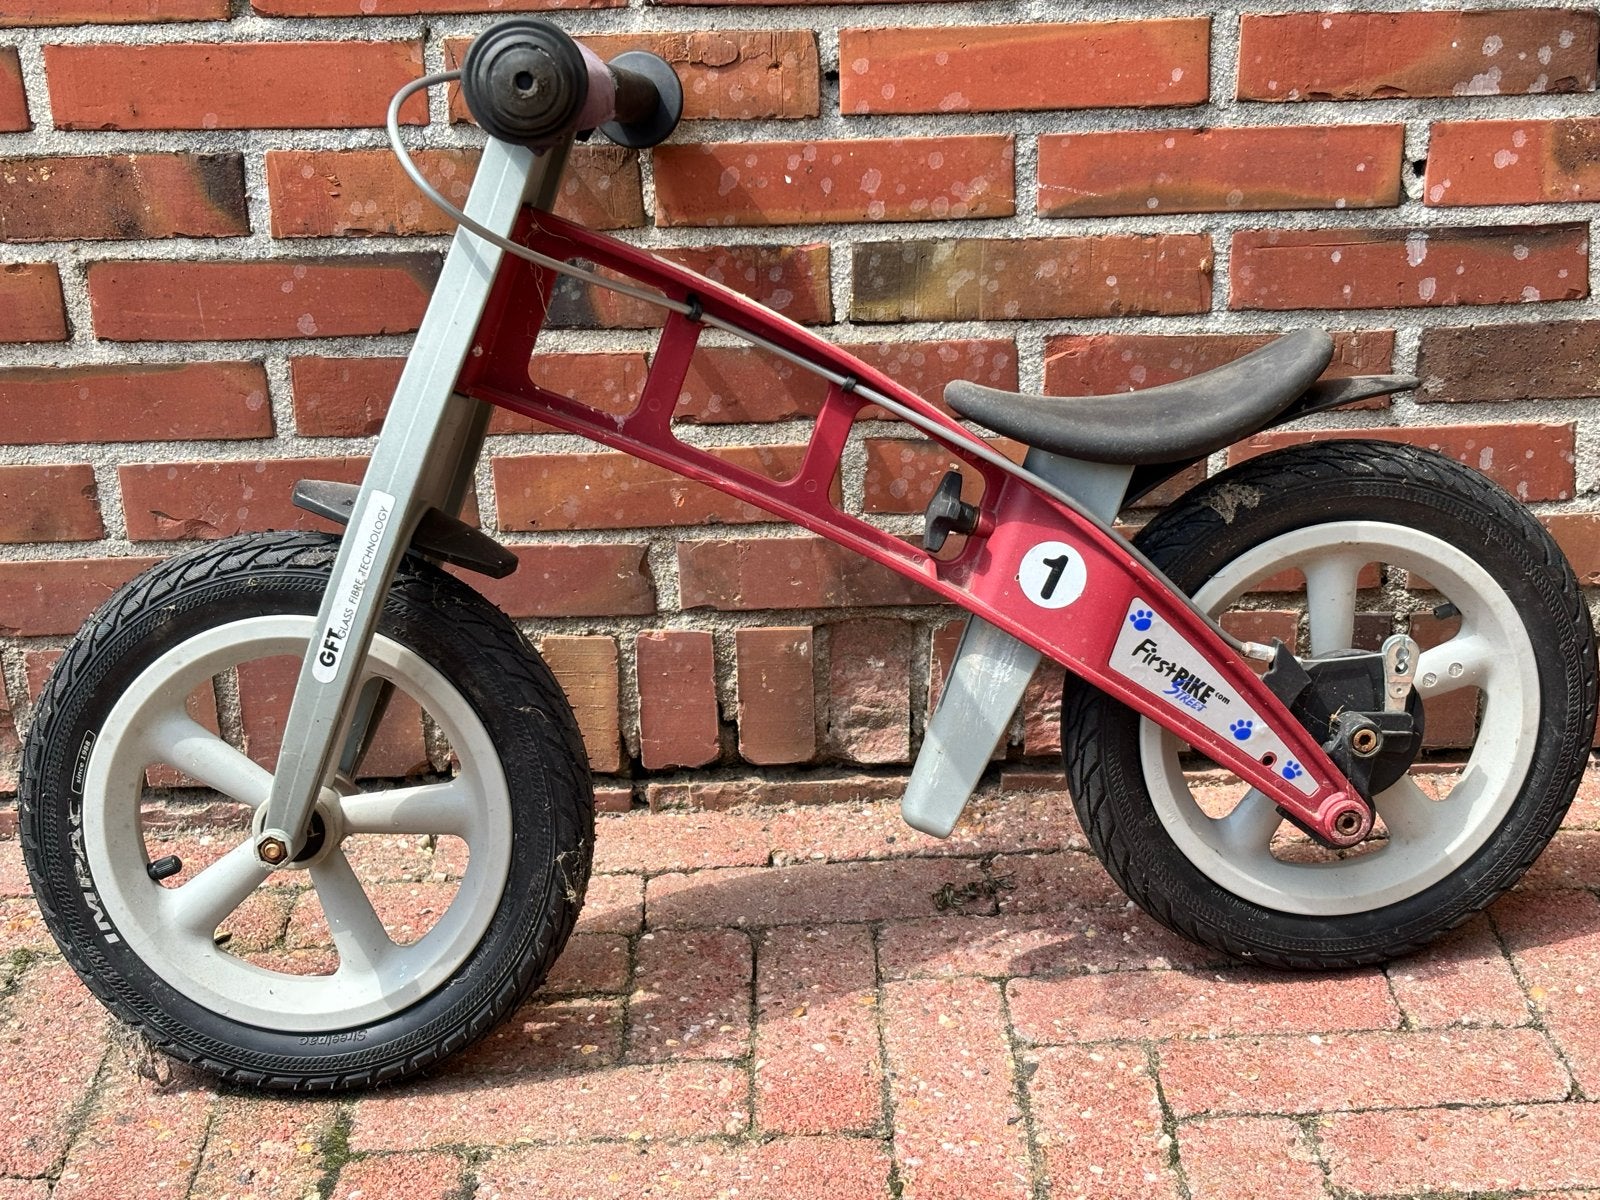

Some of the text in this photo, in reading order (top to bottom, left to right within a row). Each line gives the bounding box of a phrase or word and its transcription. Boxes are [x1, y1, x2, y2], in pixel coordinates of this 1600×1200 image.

[338, 506, 390, 640] GLASS FIBRE TECHNOLOGY
[1040, 555, 1069, 600] 1
[319, 627, 340, 668] GFT
[76, 739, 92, 784] since 1988
[298, 1028, 368, 1046] Streetpac
